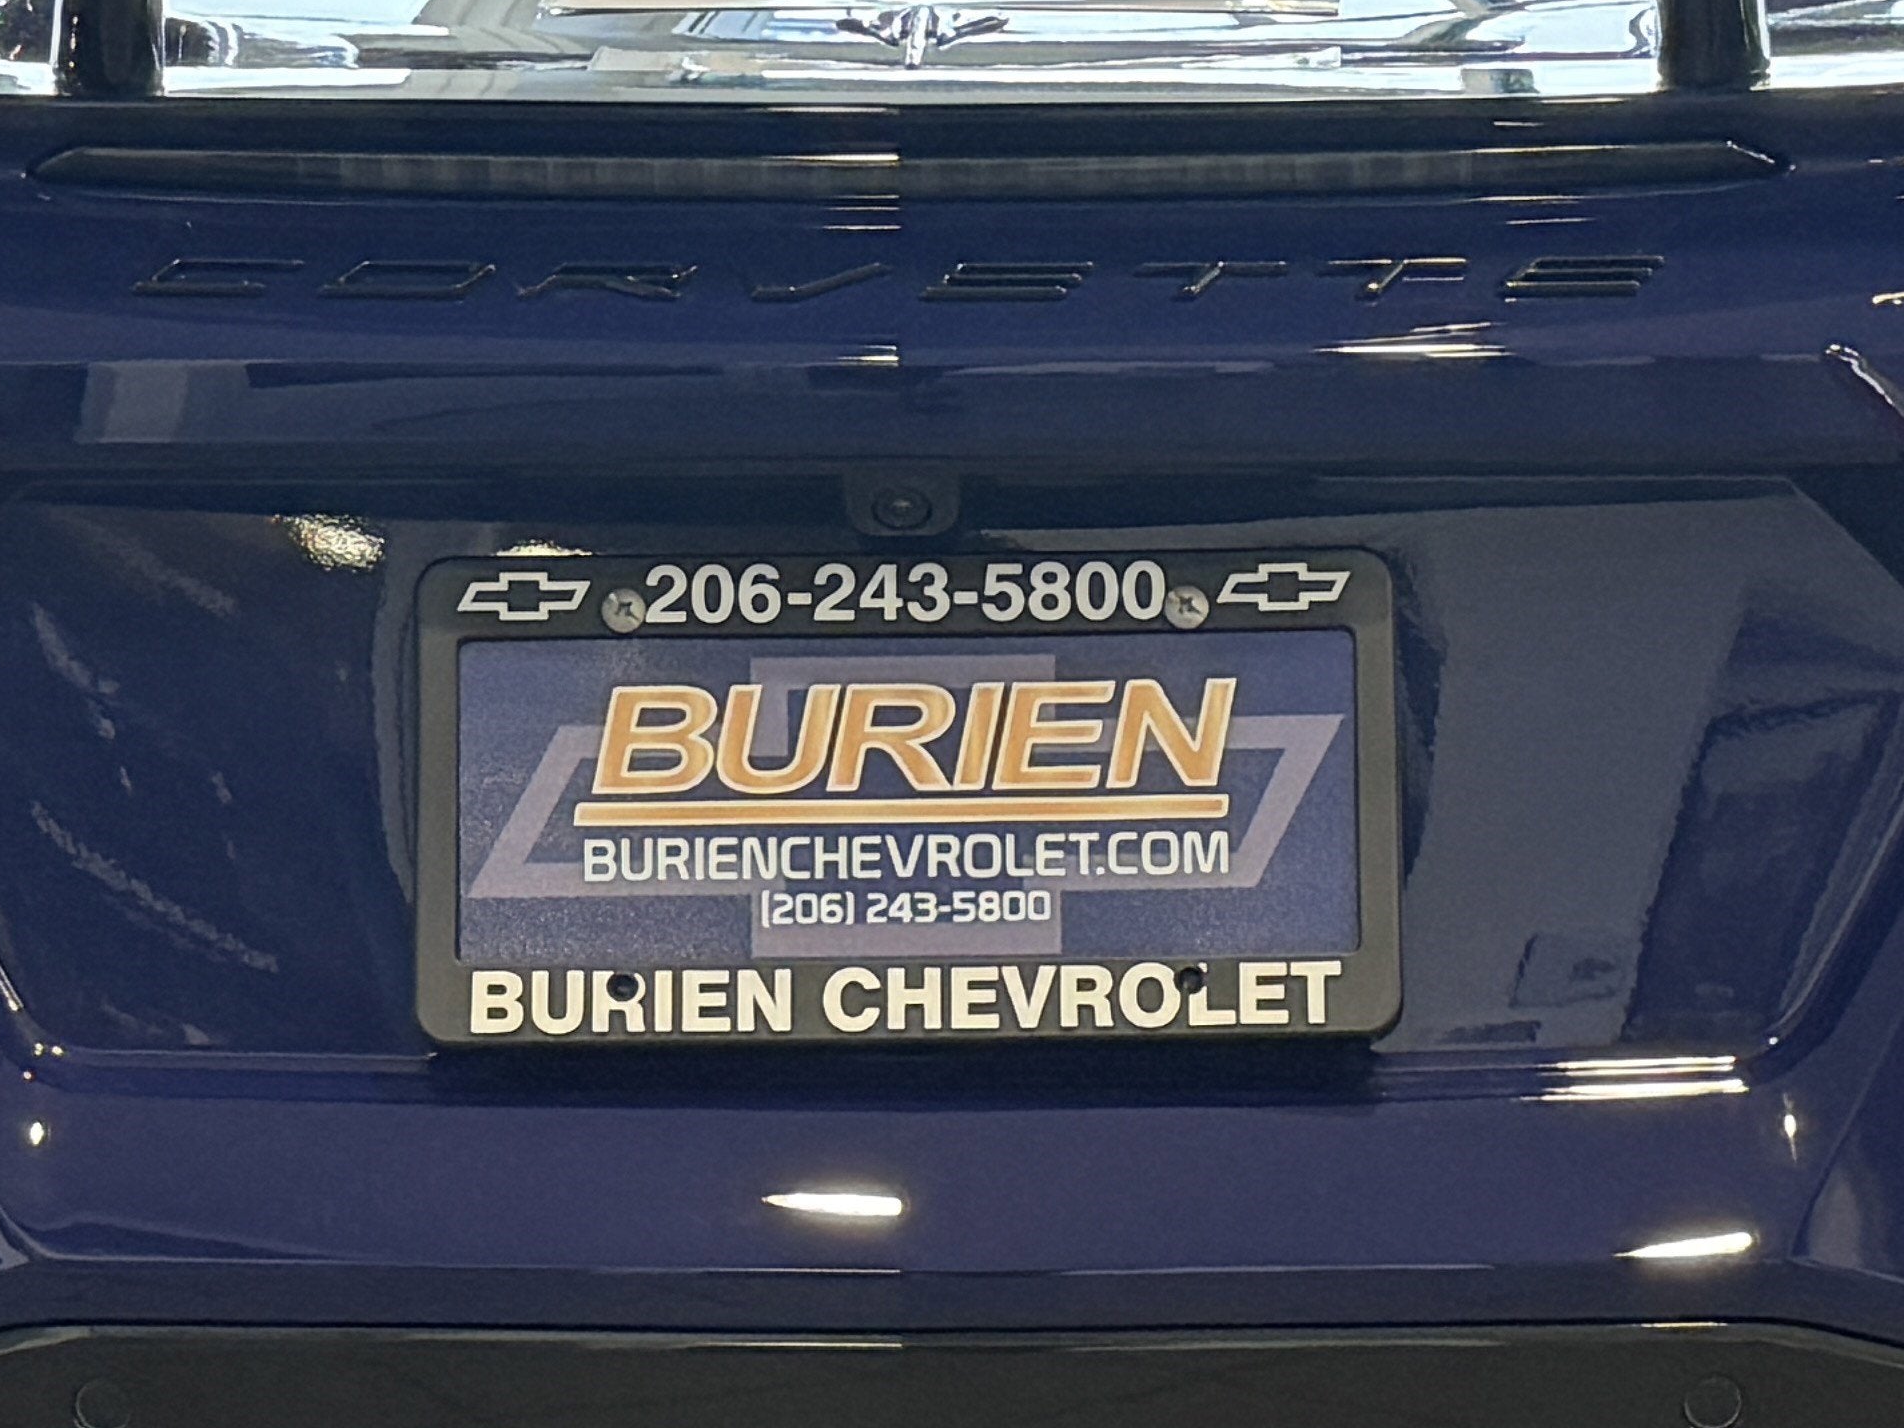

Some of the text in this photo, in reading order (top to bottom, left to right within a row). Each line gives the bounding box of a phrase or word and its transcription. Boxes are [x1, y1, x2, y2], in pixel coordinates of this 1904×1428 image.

[644, 560, 1167, 624] 206-243-5800
[599, 678, 1238, 795] BURIEN
[583, 831, 1230, 883] BURIENCHEVROLET.COM
[760, 890, 1052, 926] (206) 243-5800
[469, 961, 1343, 1036] BURIEN CHEVROLET
